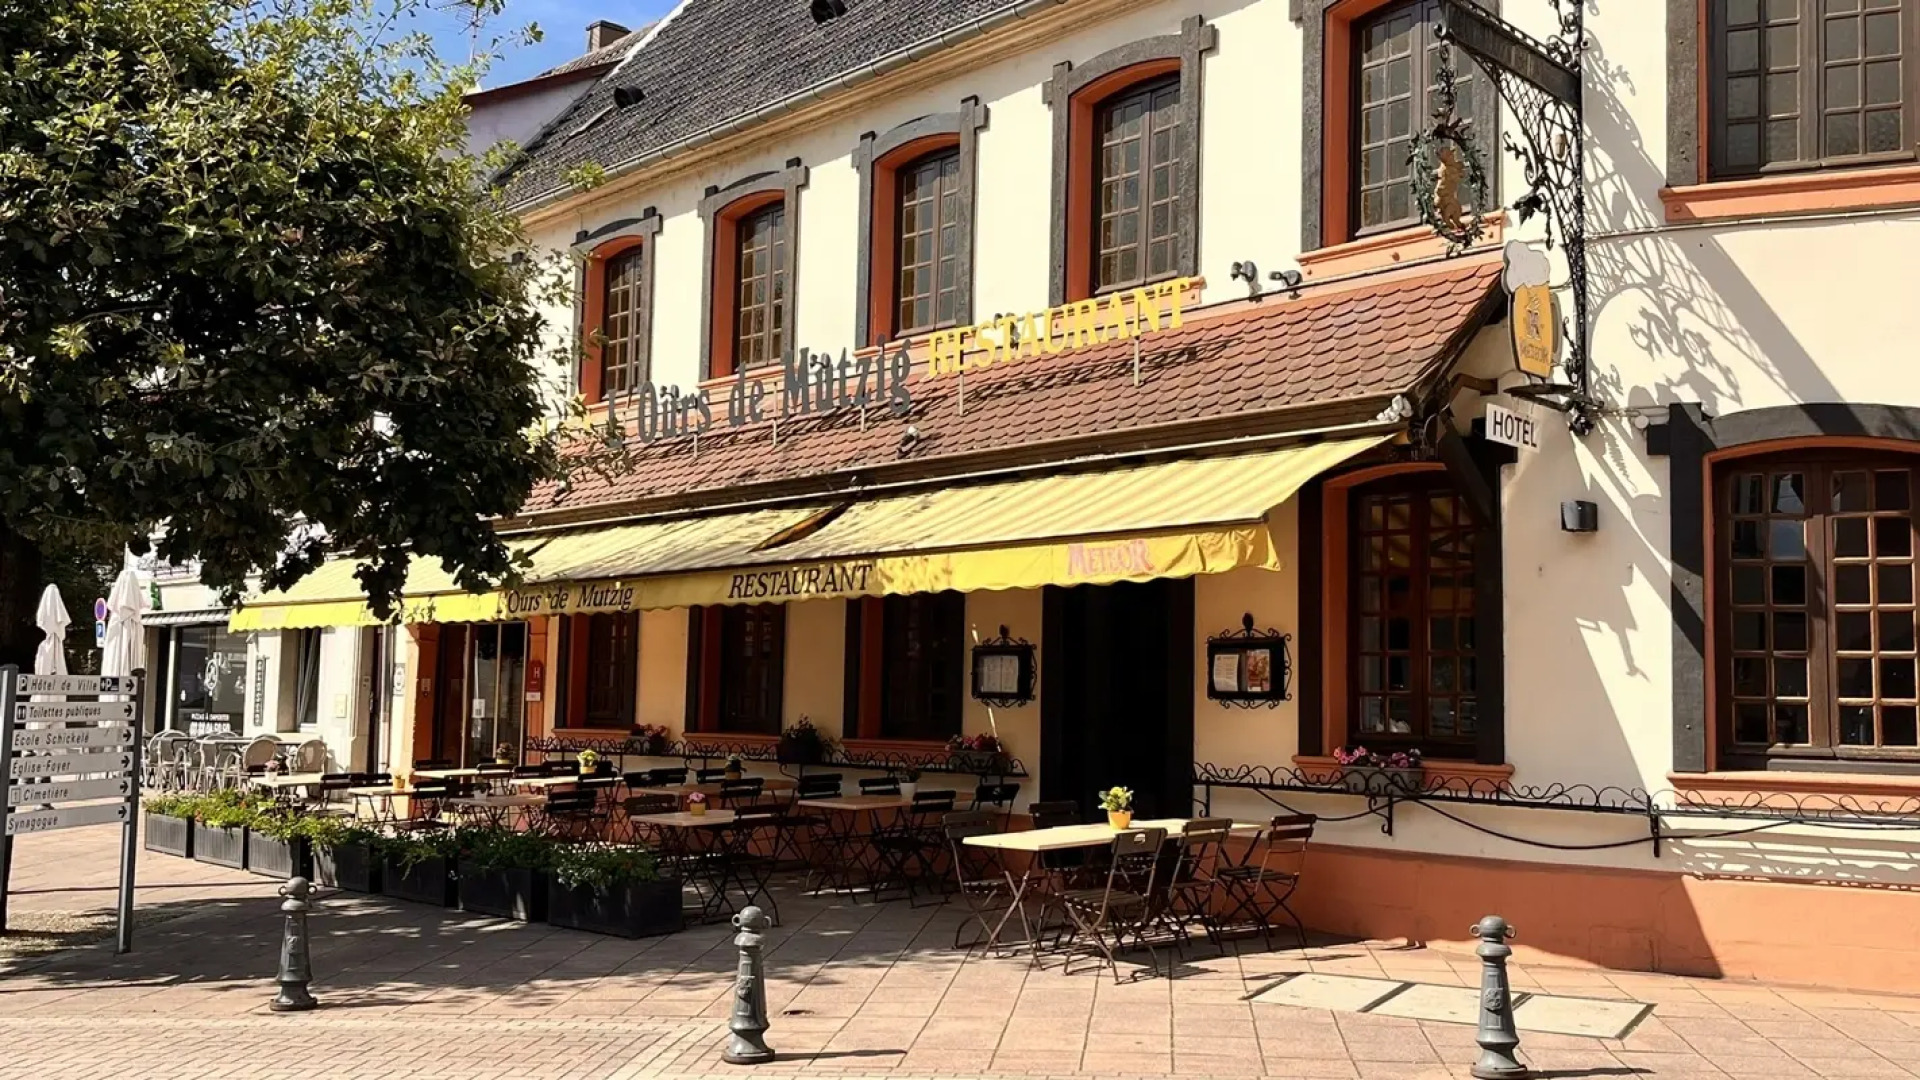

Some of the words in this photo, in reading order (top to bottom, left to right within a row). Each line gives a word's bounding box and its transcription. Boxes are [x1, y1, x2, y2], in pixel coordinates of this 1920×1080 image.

[929, 277, 1189, 378] RESTAURANT
[728, 361, 764, 425] de
[1492, 410, 1538, 448] HOTEL
[1067, 539, 1156, 576] METEOR
[728, 563, 873, 599] RESTAURANT
[549, 585, 569, 610] de
[576, 585, 634, 611] Mutzig
[30, 677, 56, 691] Hôtel
[60, 678, 71, 691] de
[77, 678, 98, 691] Ville
[29, 705, 63, 718] Toilettes
[65, 704, 101, 719] publiques
[14, 729, 40, 746] École
[45, 731, 90, 745] Schickelé
[12, 756, 71, 777] Église-Foyer
[23, 787, 69, 802] Cimetière
[8, 815, 59, 832] Synagogue
